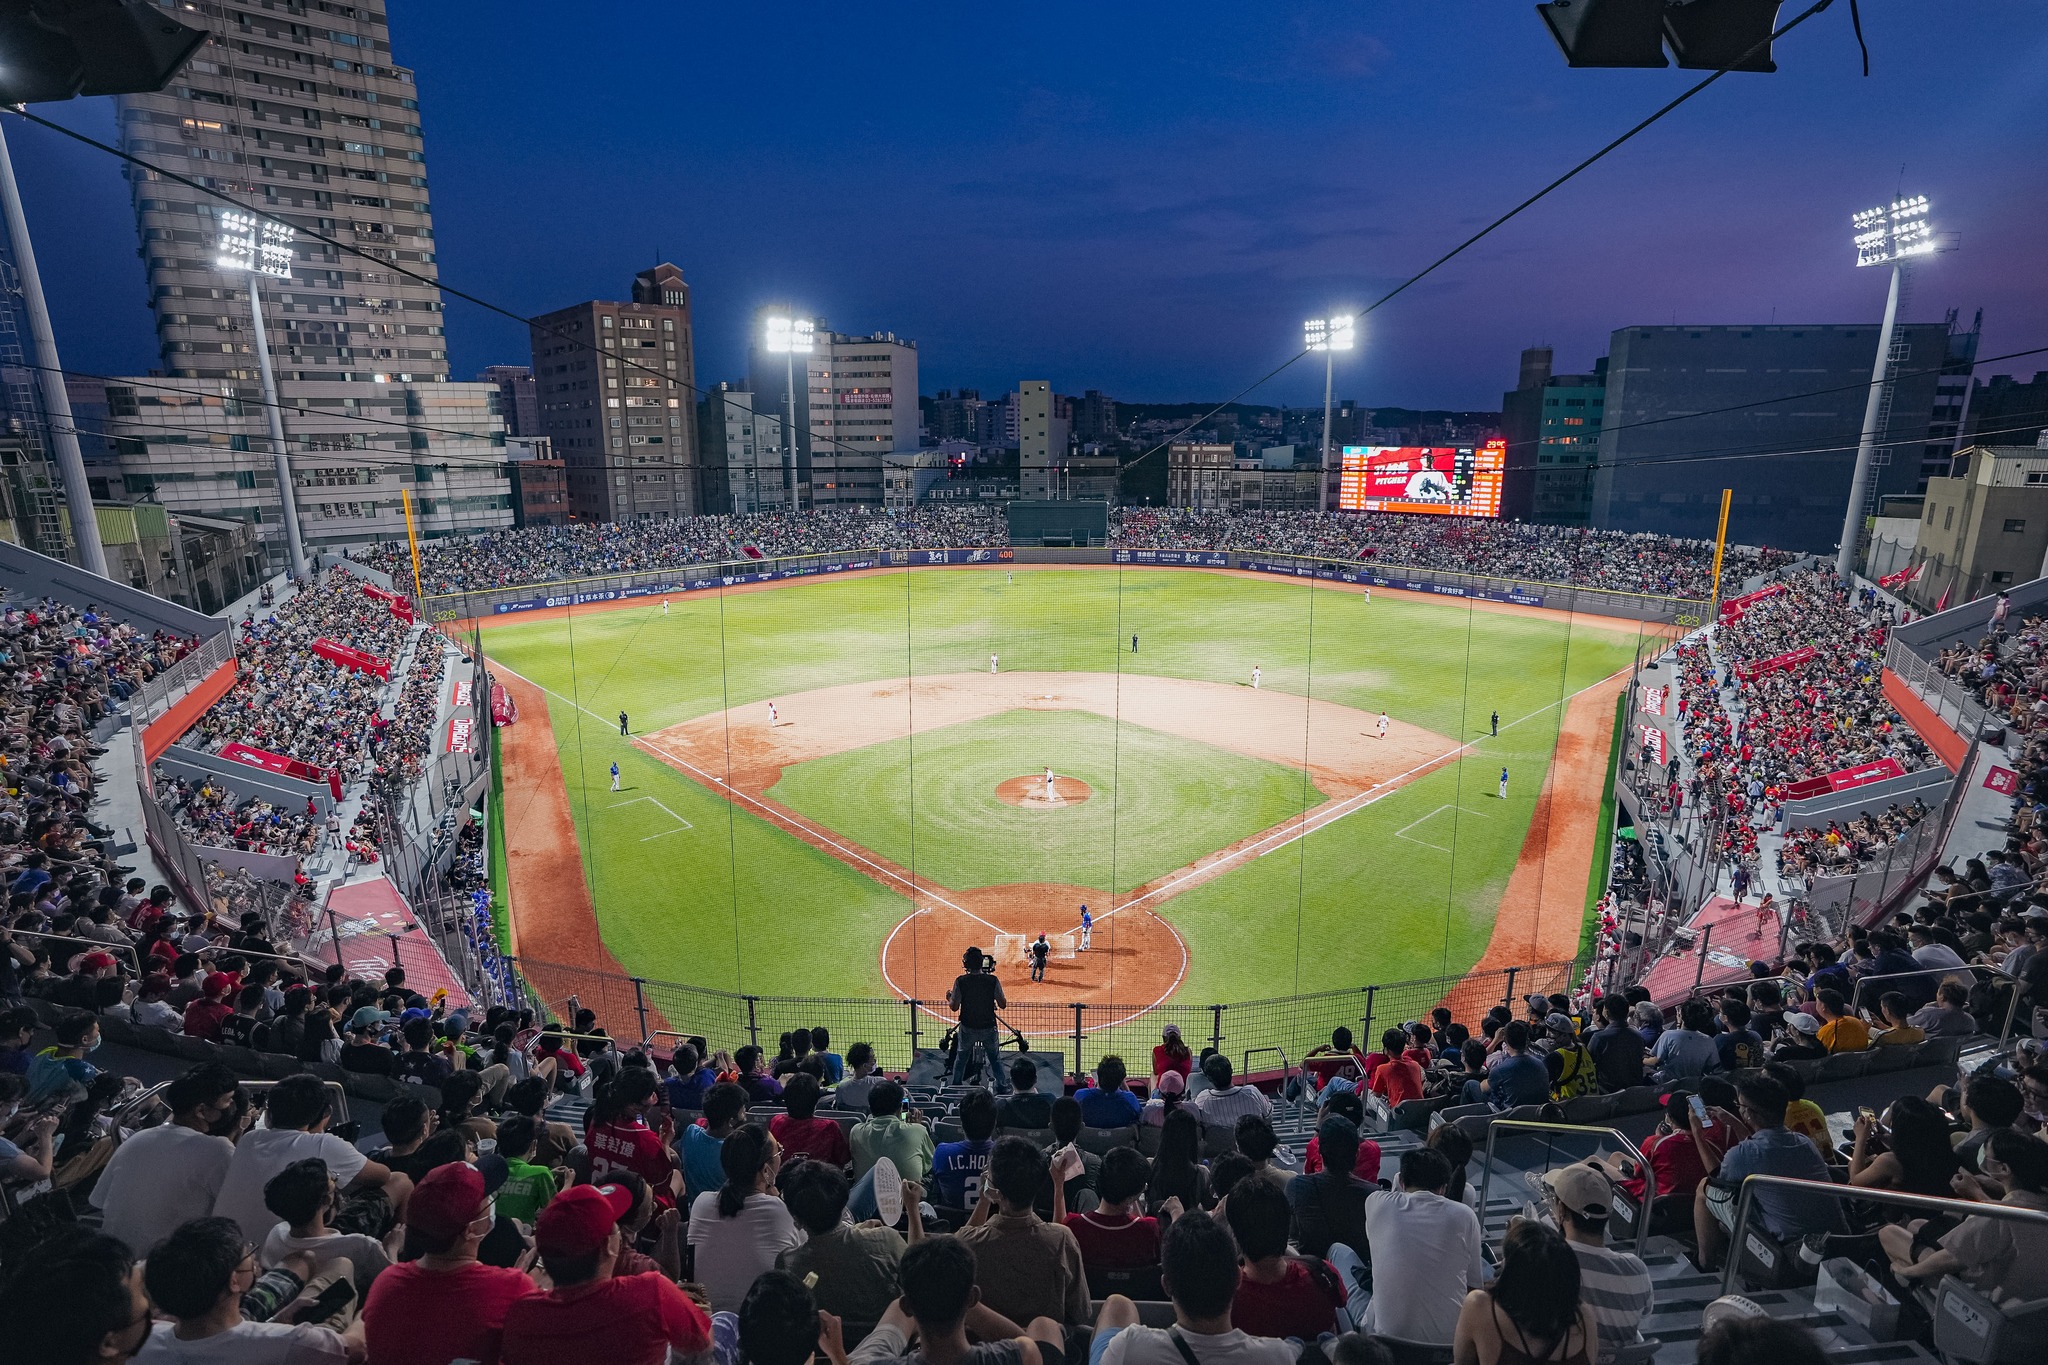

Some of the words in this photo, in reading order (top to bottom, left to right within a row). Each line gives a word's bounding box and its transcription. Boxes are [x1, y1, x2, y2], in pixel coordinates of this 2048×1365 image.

[1375, 476, 1408, 485] PITCHER
[999, 551, 1013, 559] 400
[432, 610, 457, 622] 328
[451, 719, 475, 754] DRAGONS
[1576, 1071, 1597, 1095] 35
[594, 1132, 635, 1158] 葉君璋
